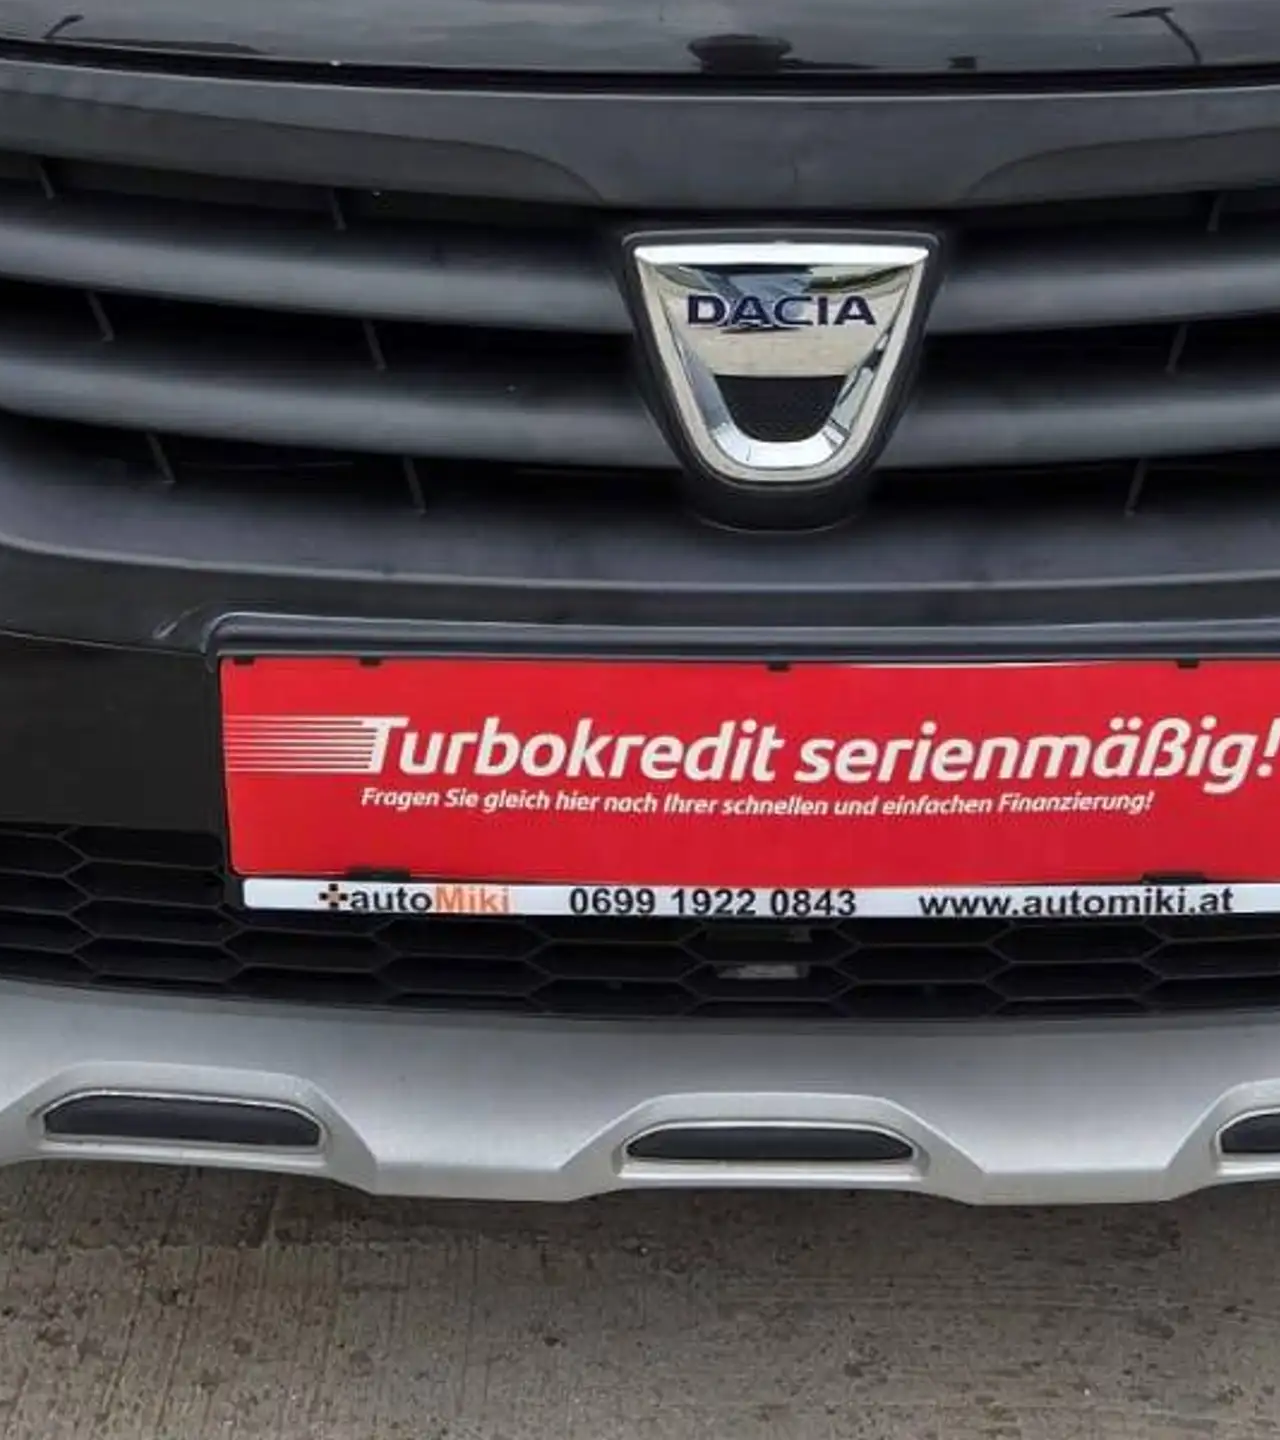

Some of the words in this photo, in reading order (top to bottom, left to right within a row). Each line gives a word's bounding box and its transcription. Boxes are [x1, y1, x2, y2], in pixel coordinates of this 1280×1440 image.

[686, 294, 877, 326] DACIA
[360, 716, 785, 782] Turbokredit
[361, 787, 440, 811] Fragen
[444, 788, 479, 809] Sie
[483, 789, 550, 813] gleich
[554, 790, 600, 812] hier
[604, 792, 658, 814] nach
[663, 793, 718, 814] Ihrer
[721, 794, 828, 816] schnellen
[834, 795, 878, 816] und
[882, 794, 992, 815] einfachen
[997, 790, 1155, 814] Finanzierung!
[350, 885, 510, 915] autoMiki
[569, 888, 656, 915] 0699
[671, 889, 757, 916] 1922
[769, 890, 858, 917] 0843
[919, 887, 1234, 917] www.automiki.at
